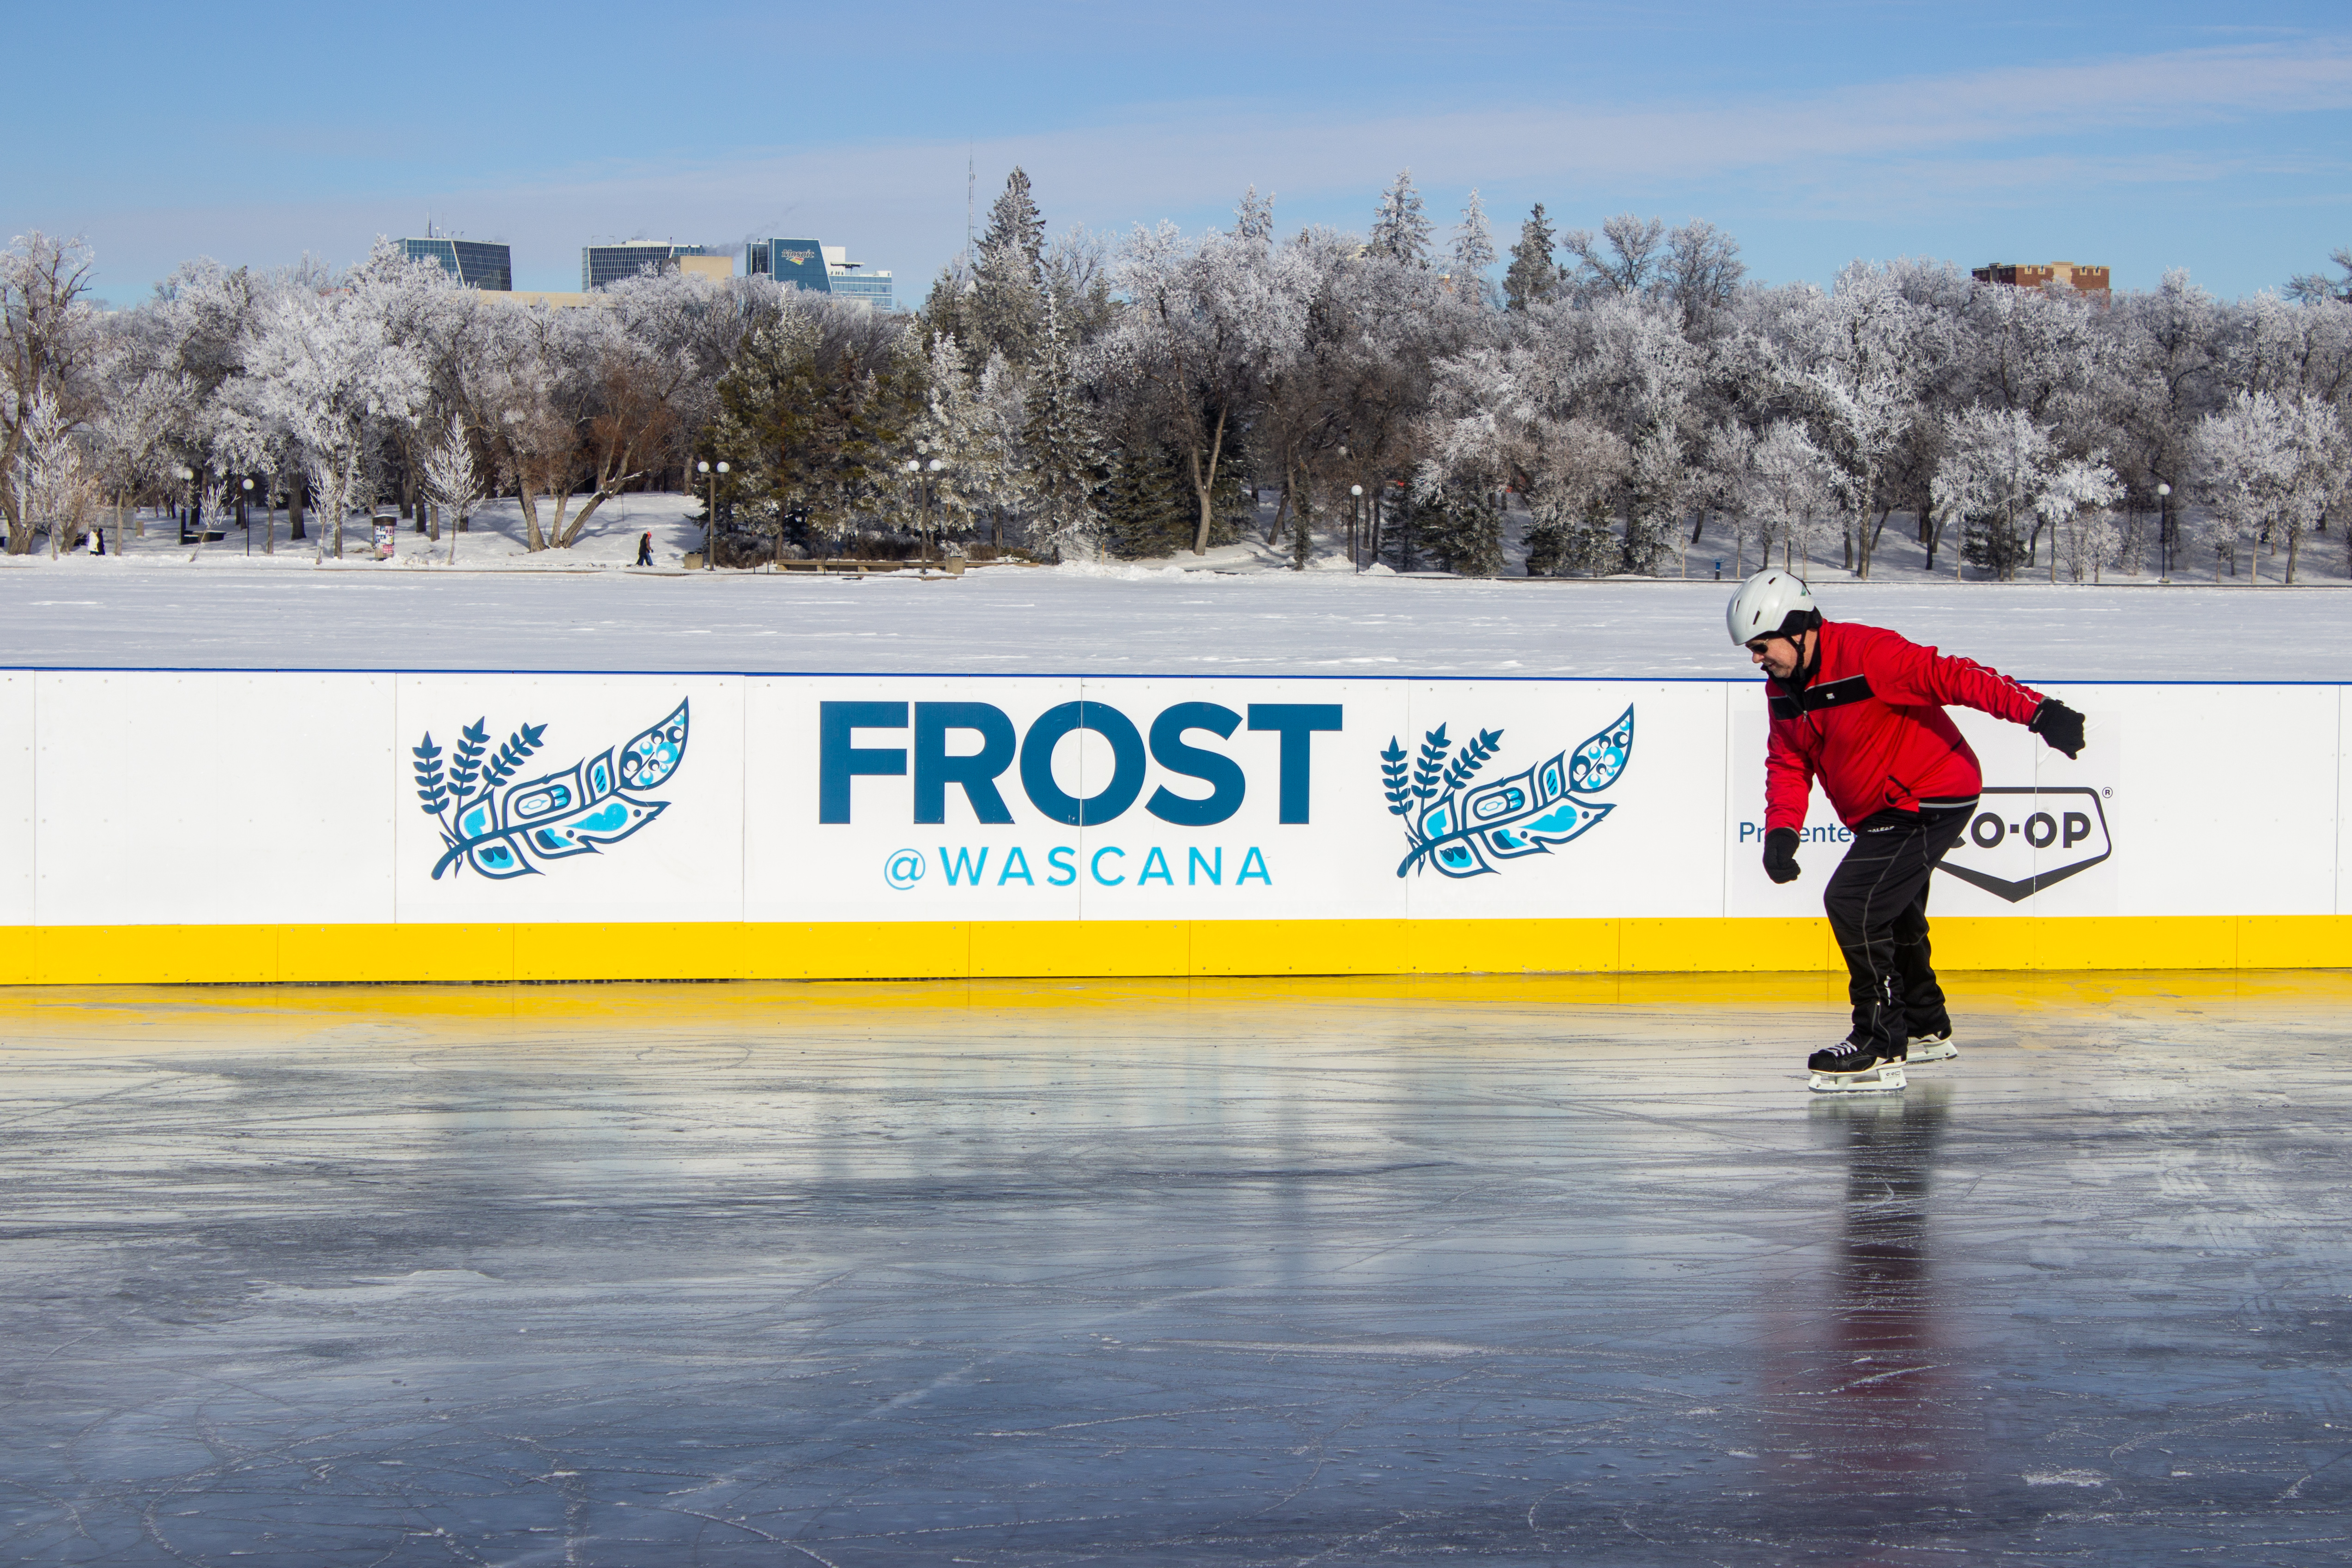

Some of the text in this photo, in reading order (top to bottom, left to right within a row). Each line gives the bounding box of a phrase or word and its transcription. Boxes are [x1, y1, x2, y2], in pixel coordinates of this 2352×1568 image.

[781, 249, 815, 258] Mosaic
[819, 701, 1343, 826] FROST
[1740, 822, 1857, 842] Prente
[1949, 812, 2091, 848] O-OP
[884, 846, 1273, 890] @WASCANA
